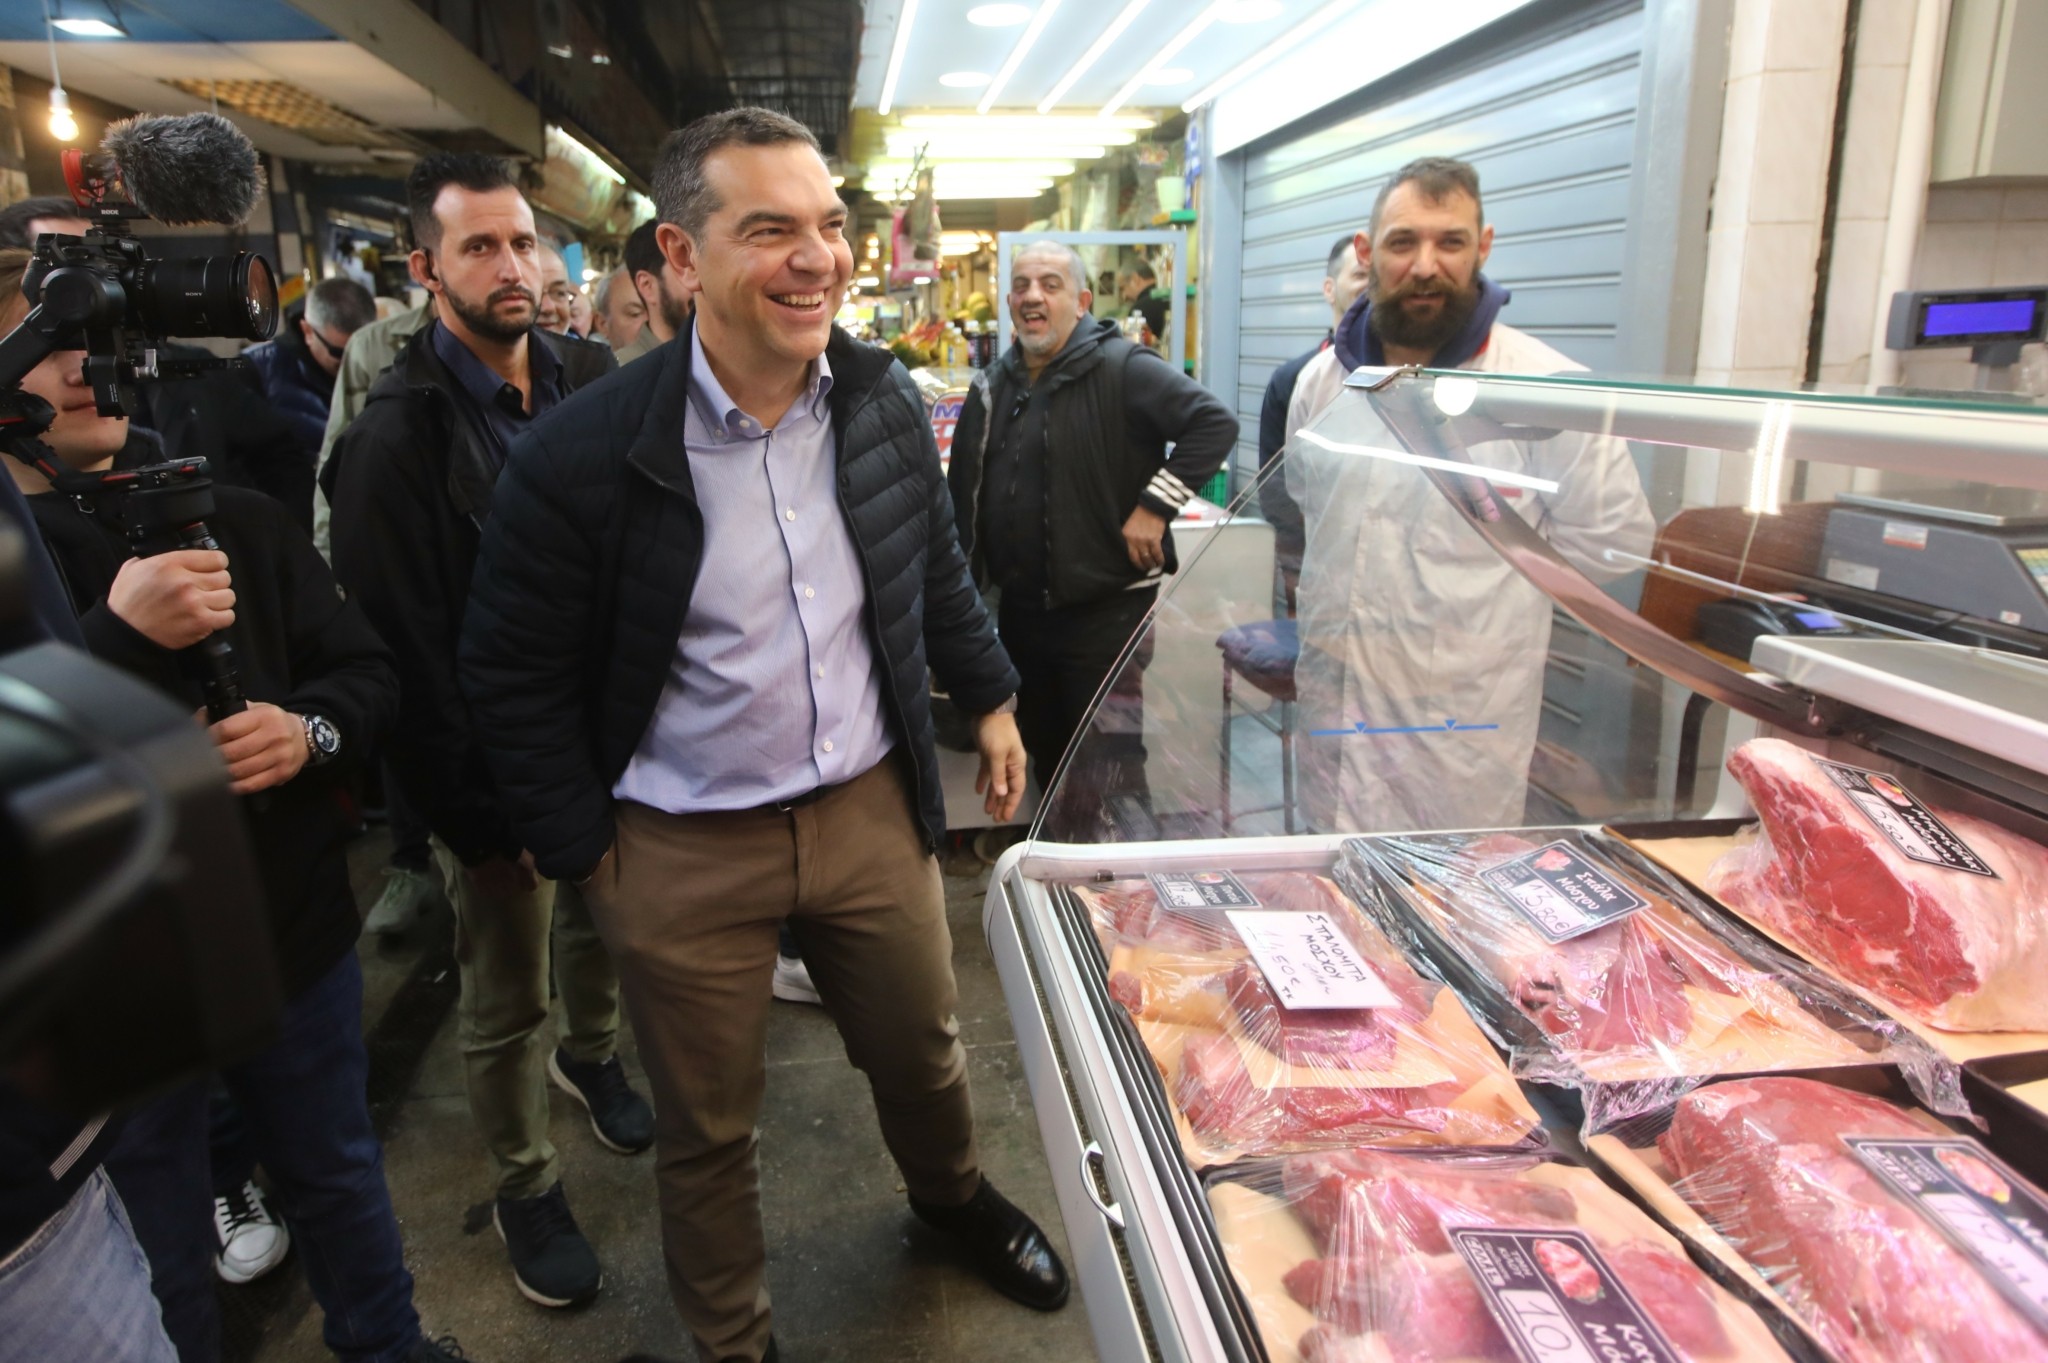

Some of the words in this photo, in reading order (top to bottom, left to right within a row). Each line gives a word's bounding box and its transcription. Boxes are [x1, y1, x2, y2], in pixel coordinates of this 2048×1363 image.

[1555, 877, 1600, 910] Μόσχου
[1576, 871, 1618, 902] Σπάλα
[1299, 934, 1345, 980] ΜΟΣΧΟΥ
